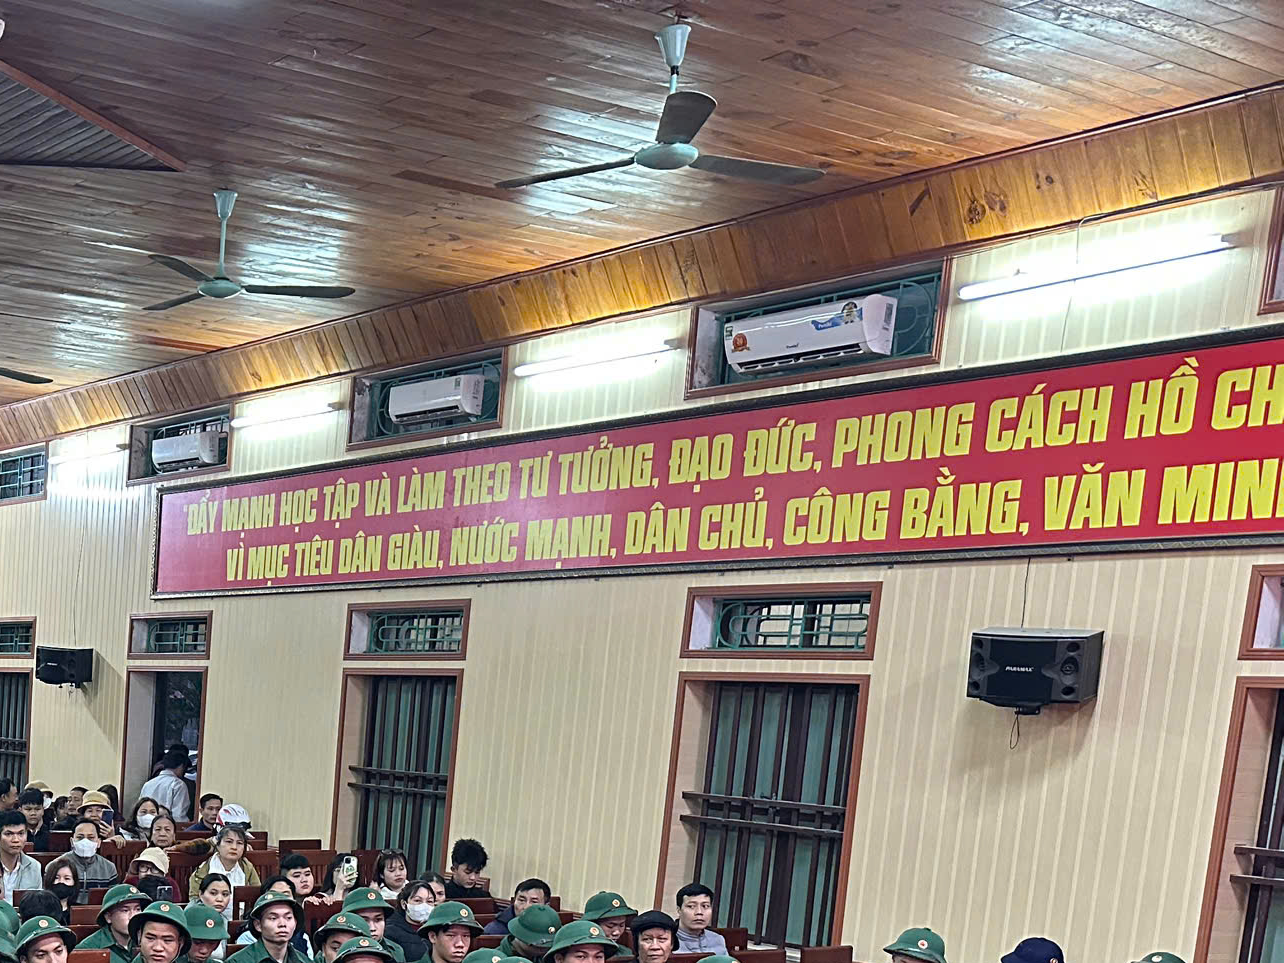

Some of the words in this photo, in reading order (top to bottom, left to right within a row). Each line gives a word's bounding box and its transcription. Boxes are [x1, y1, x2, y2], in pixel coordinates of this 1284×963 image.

[221, 493, 276, 539] MẠNH
[279, 487, 318, 533] HỌC
[323, 477, 361, 529] TẬP
[364, 471, 391, 517] VÀ
[396, 467, 447, 514] LÀM
[452, 461, 512, 507] THEO
[519, 451, 553, 499] TƯ
[558, 435, 660, 495] TƯỞNG,
[668, 433, 734, 493] ĐẠO
[743, 417, 822, 477] ĐỨC,
[831, 401, 976, 469] PHONG
[985, 382, 1114, 453] CÁCH
[1123, 356, 1200, 440] HỒ
[226, 541, 245, 582] VÌ
[246, 543, 290, 587] MỤC
[294, 534, 335, 577] TIÊU
[338, 530, 383, 574] DÂN
[387, 525, 444, 571] GIÀU,
[449, 516, 520, 567] NƯỚC
[524, 513, 617, 569] MẠNH,
[624, 501, 691, 555] DÂN
[698, 487, 774, 551] CHỦ,
[783, 486, 891, 546] CÔNG
[900, 466, 1030, 538] BẰNG,
[1044, 462, 1147, 531] VĂN
[1157, 458, 1284, 525] MIN
